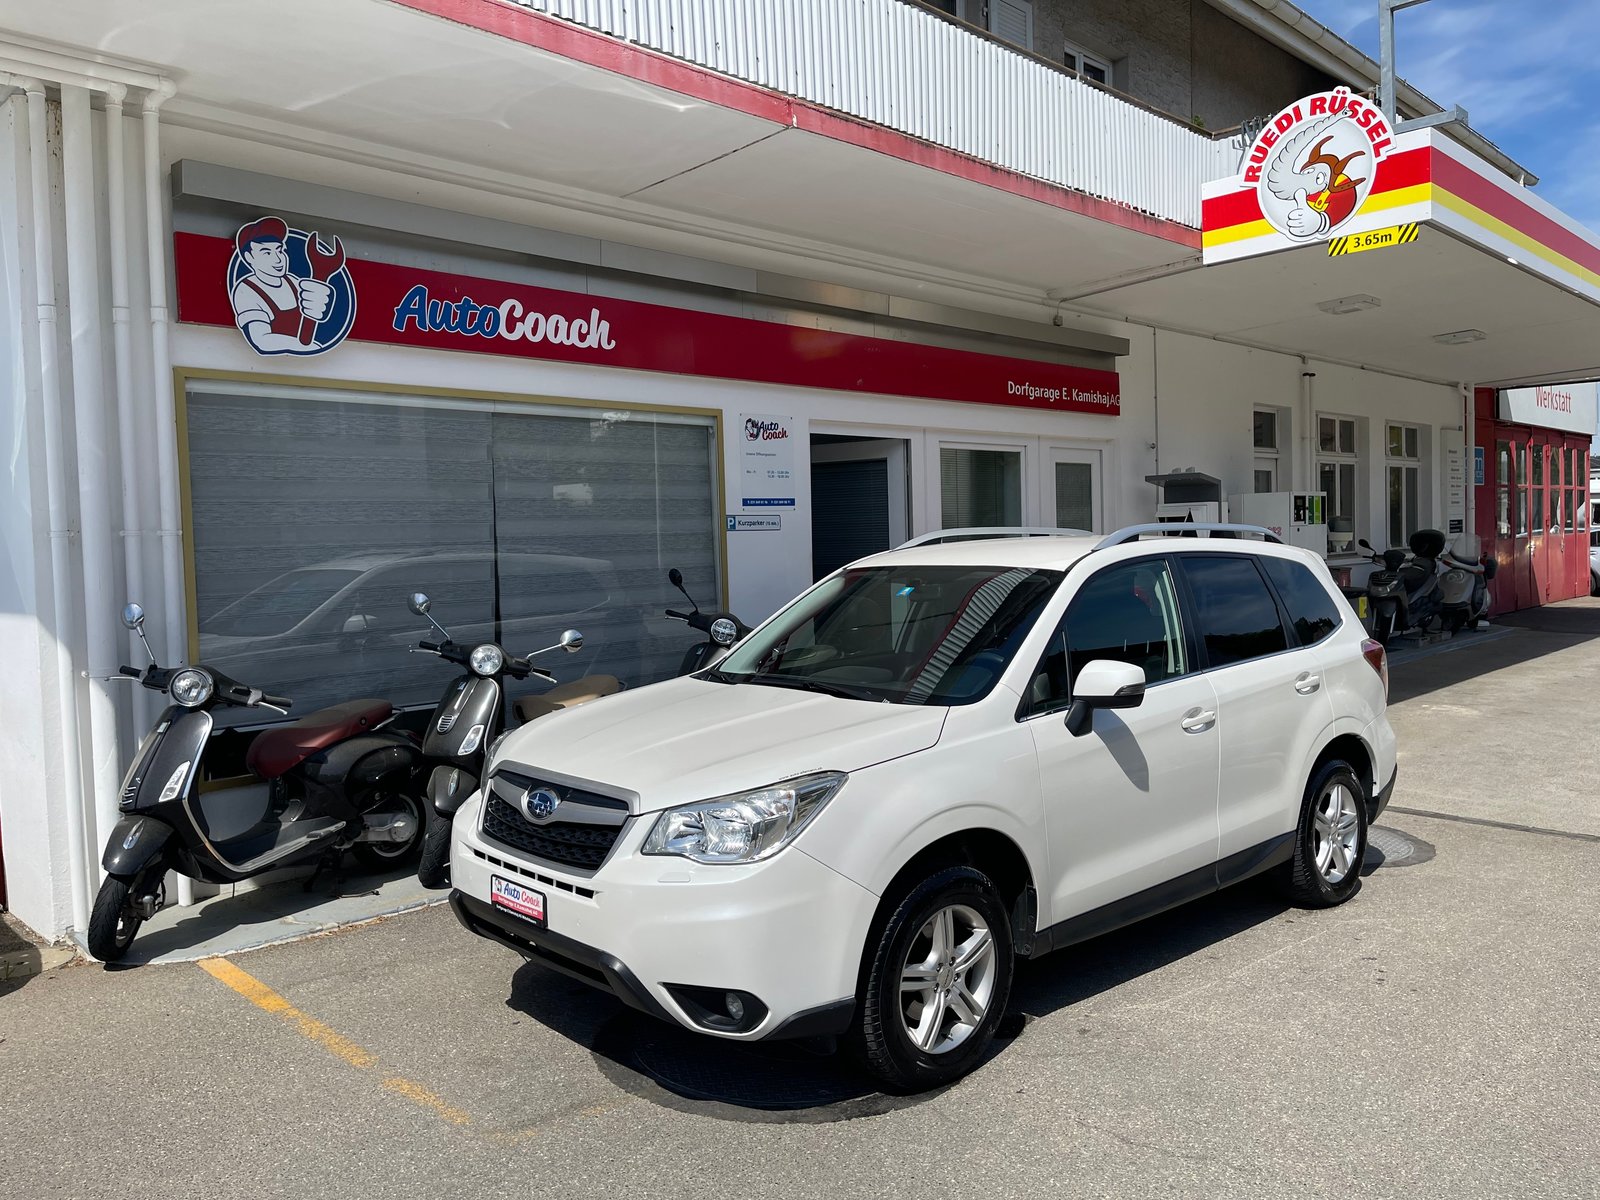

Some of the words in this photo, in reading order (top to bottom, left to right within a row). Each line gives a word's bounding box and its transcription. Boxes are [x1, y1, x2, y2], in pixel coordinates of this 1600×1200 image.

[1244, 105, 1303, 183] RUEDI
[1309, 89, 1392, 159] RÜSSEL
[1353, 232, 1393, 248] 3.65m
[1007, 380, 1060, 402] Dorfgarage
[1062, 387, 1070, 400] E.
[1535, 385, 1571, 414] Werkstatt
[759, 421, 779, 431] Auto
[762, 428, 788, 440] Coach
[737, 519, 765, 527] Kurzparker
[504, 883, 520, 900] Auto
[521, 891, 540, 908] Coach
